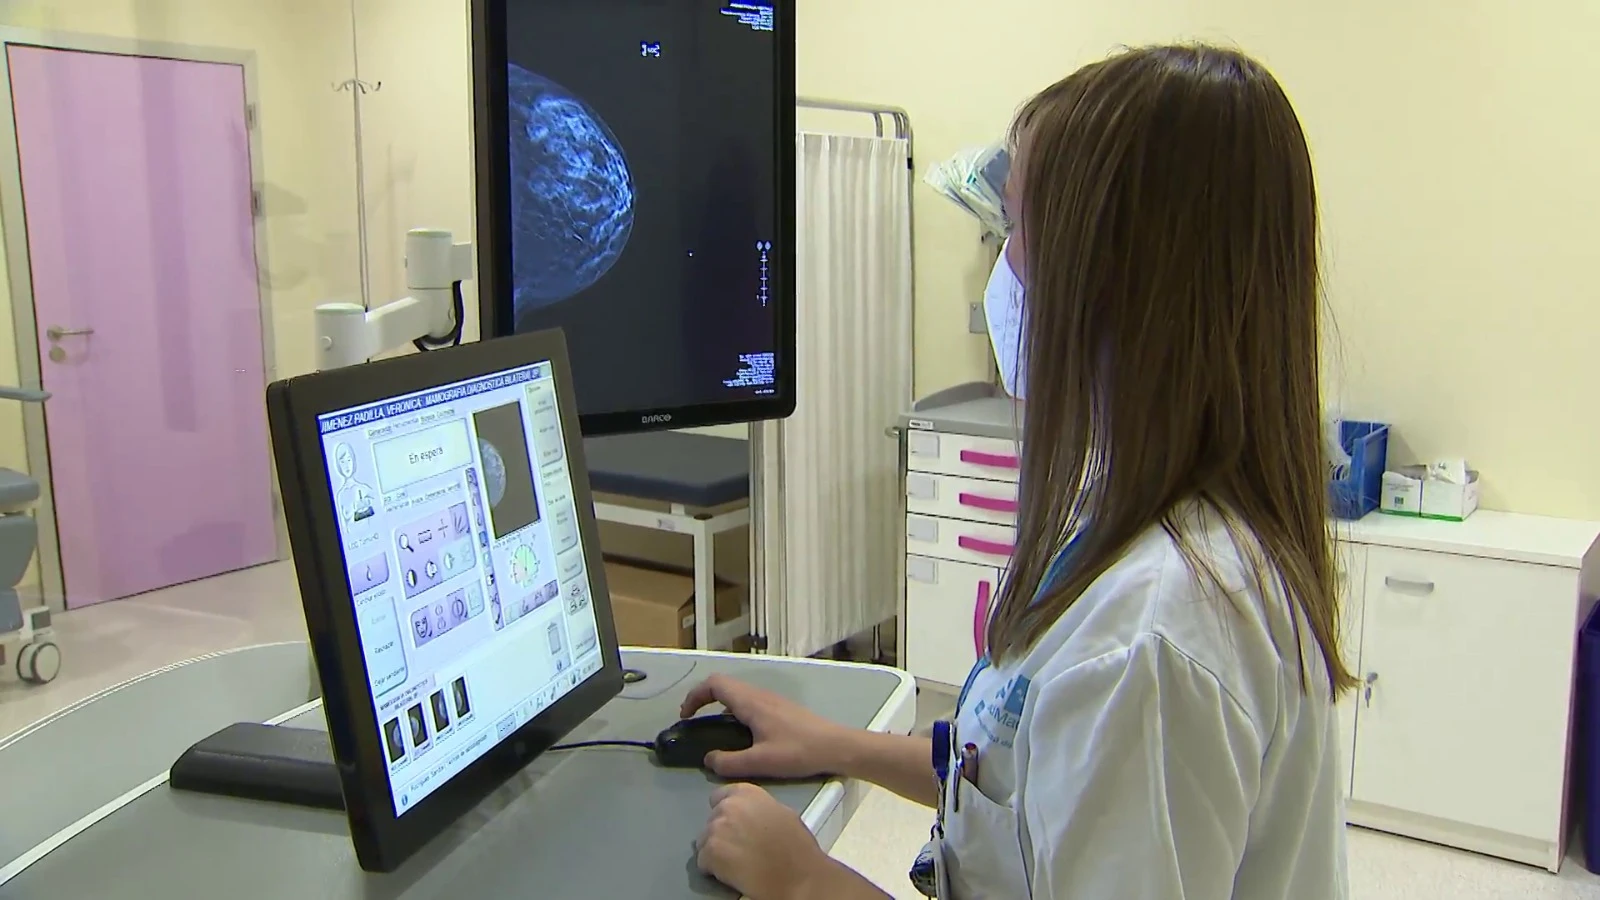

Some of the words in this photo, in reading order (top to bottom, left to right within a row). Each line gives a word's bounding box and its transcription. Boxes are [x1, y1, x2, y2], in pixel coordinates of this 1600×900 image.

[321, 414, 354, 433] JIMENEZ
[425, 385, 467, 405] MAMOGRAFIA
[641, 414, 672, 424] BARCO
[409, 453, 419, 465] En
[420, 446, 444, 462] espera
